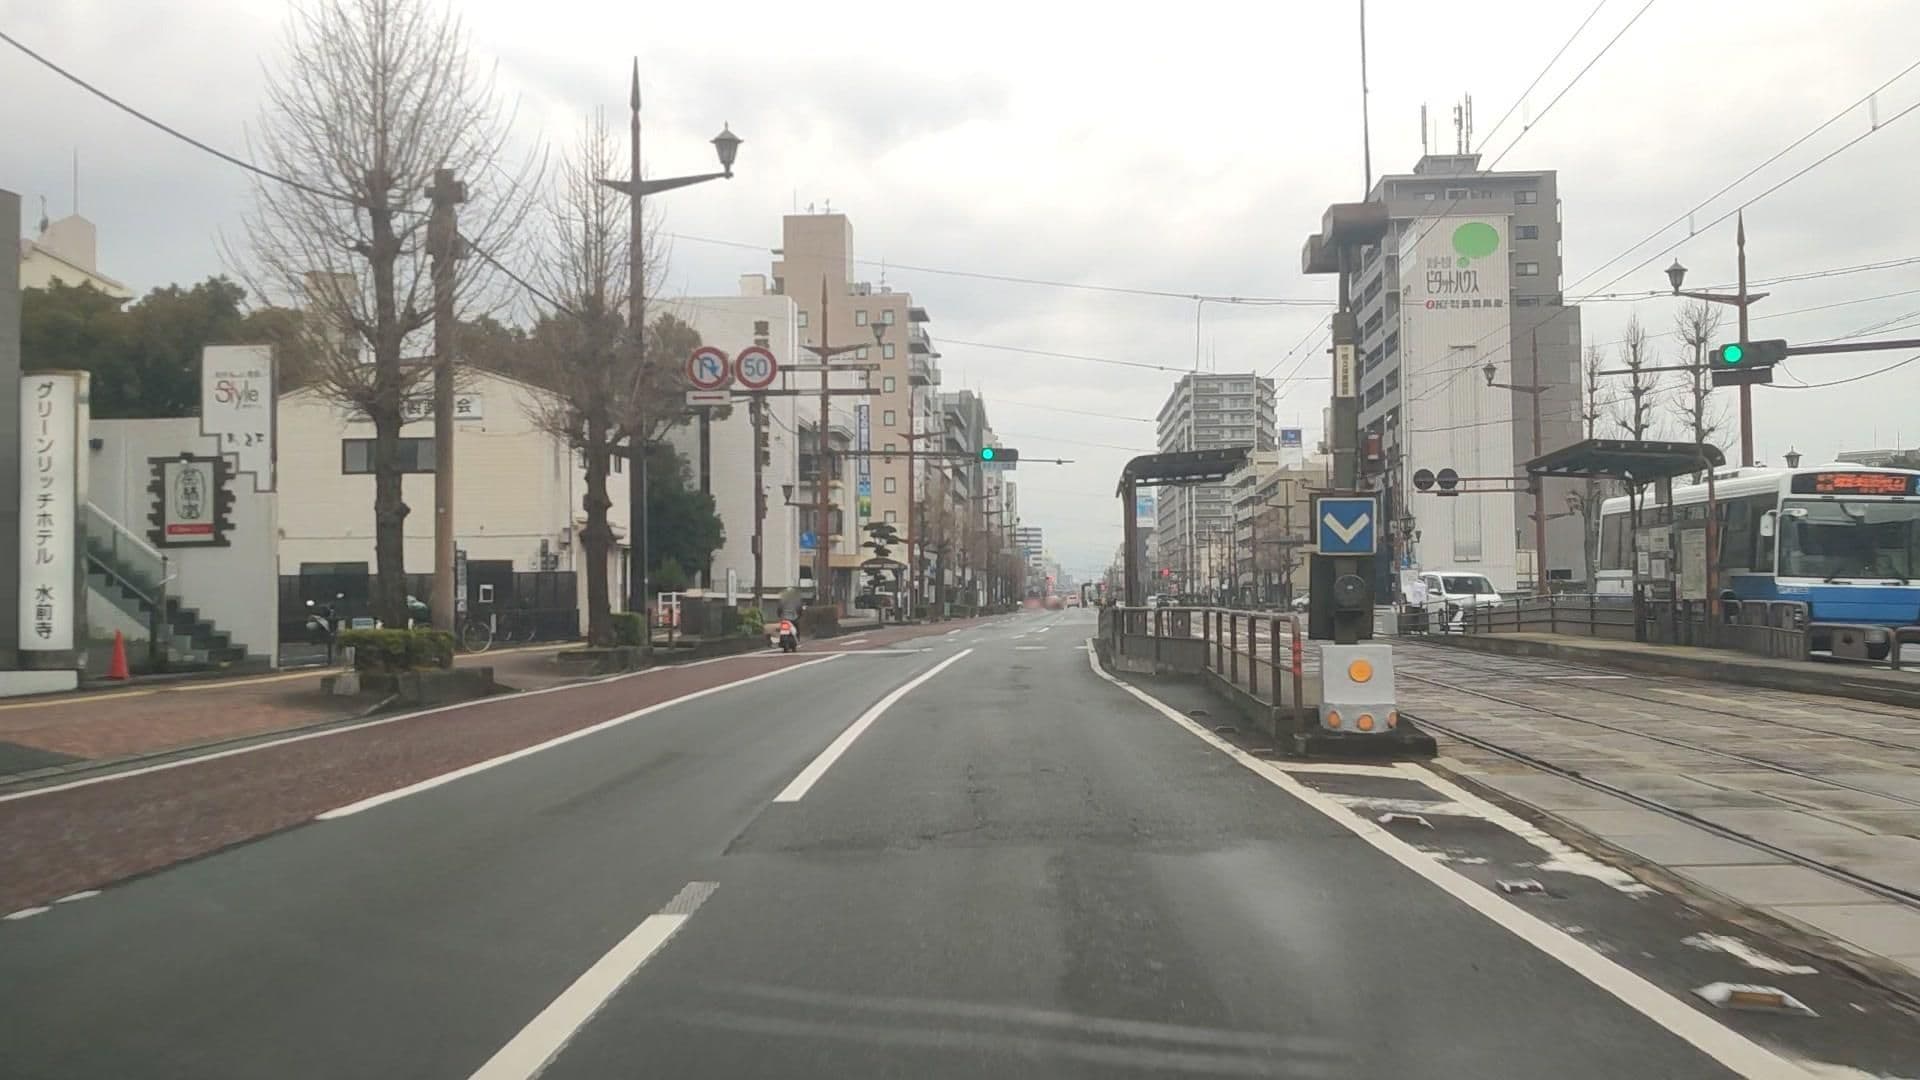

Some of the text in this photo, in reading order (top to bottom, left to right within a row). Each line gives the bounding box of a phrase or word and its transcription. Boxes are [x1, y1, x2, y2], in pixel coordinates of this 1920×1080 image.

[744, 358, 768, 377] 50
[215, 380, 260, 410] Style
[35, 381, 55, 640] グリーンリッチホテル 水前寺
